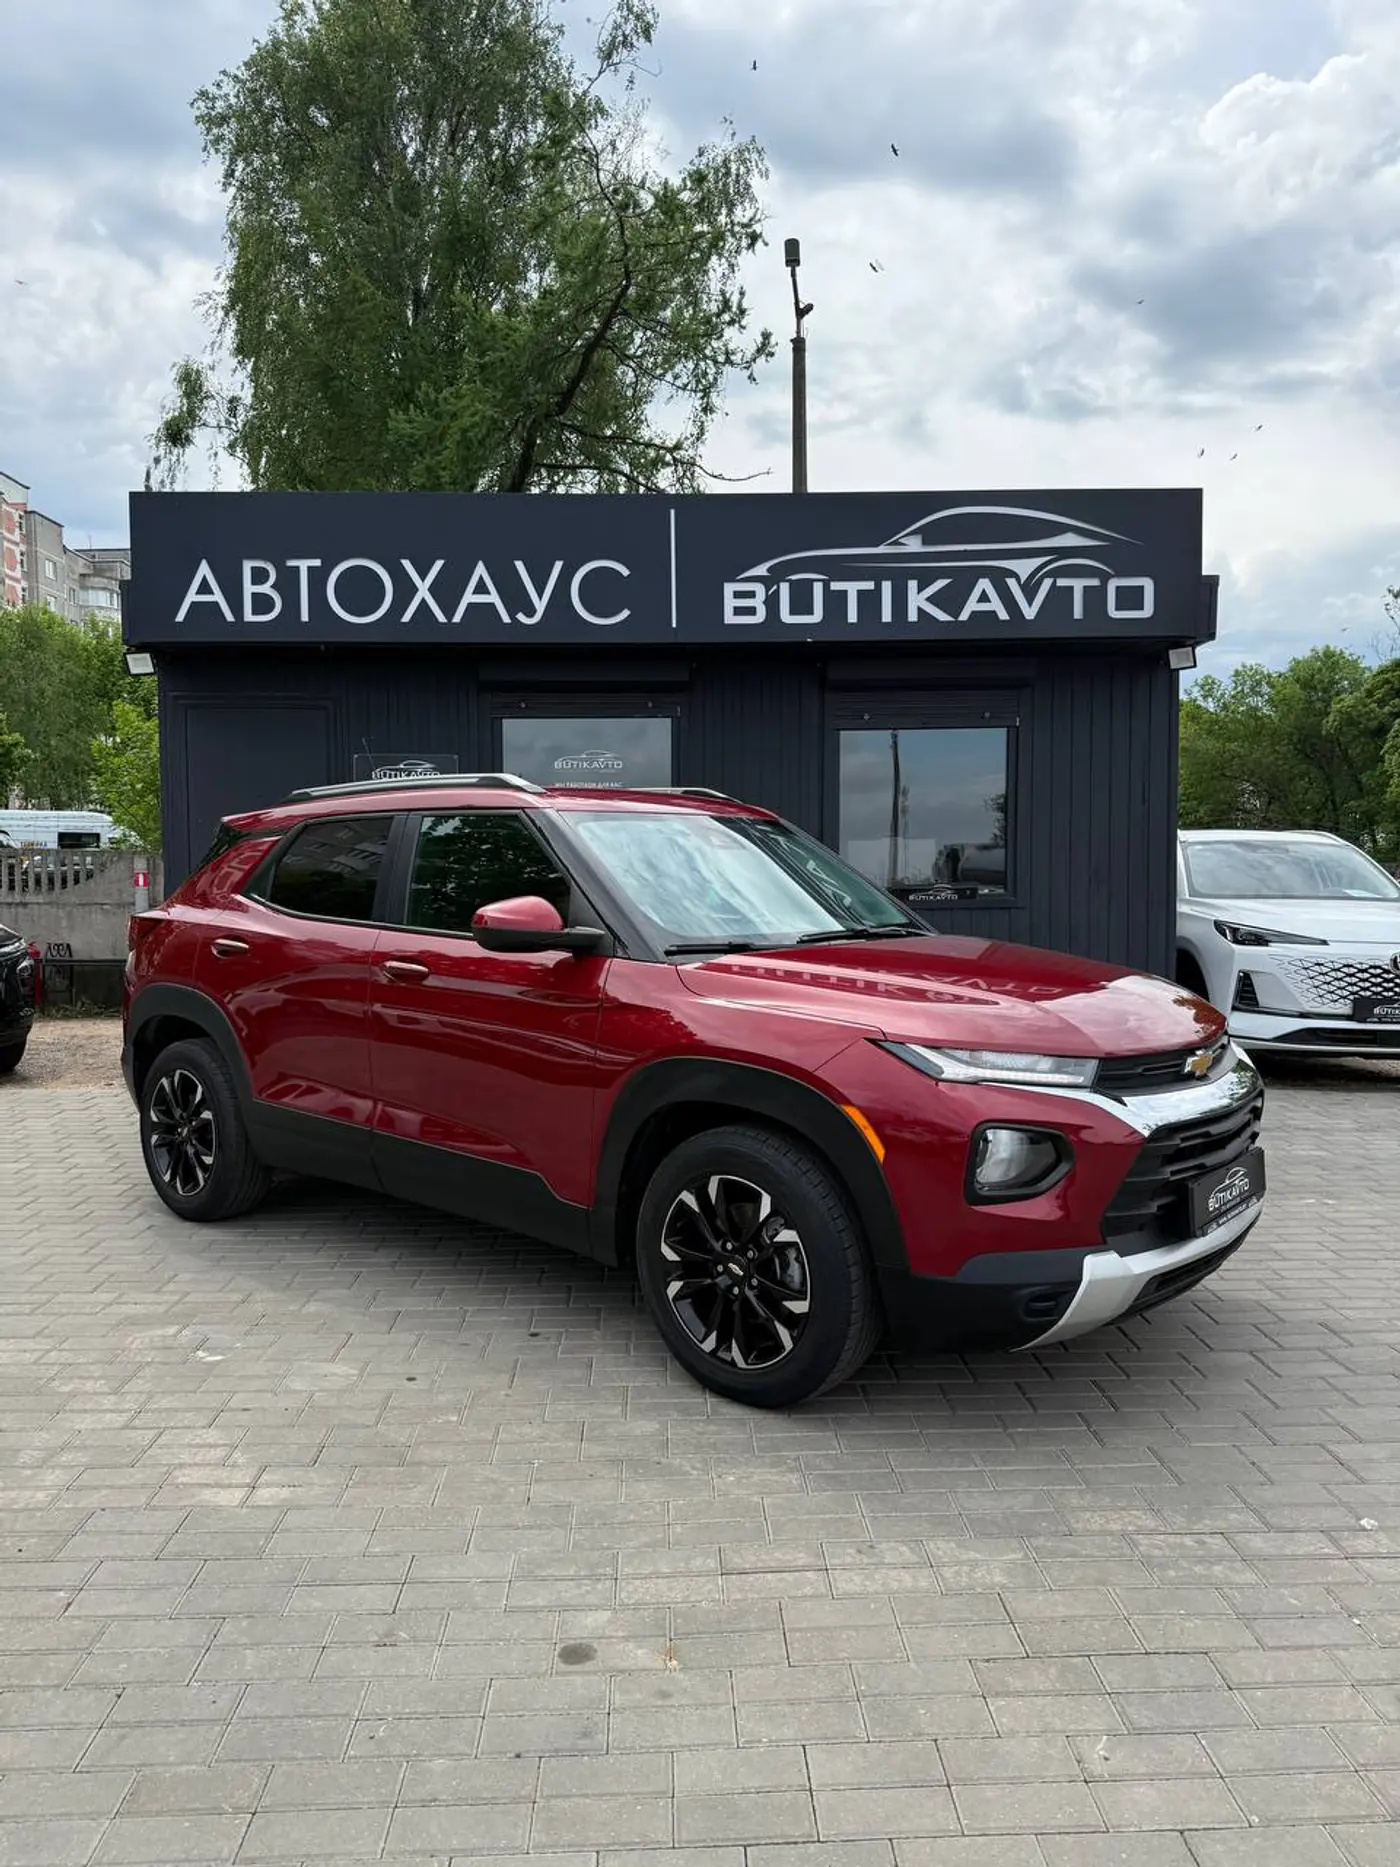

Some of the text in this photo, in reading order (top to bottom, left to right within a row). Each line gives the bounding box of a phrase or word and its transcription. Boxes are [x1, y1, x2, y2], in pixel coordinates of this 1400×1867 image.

[174, 557, 632, 626] АВТОХАУС
[723, 576, 1155, 624] BUTIKAVTO
[554, 760, 623, 769] BUTIKAVTO
[1207, 1178, 1250, 1212] BUTIKAVTO
